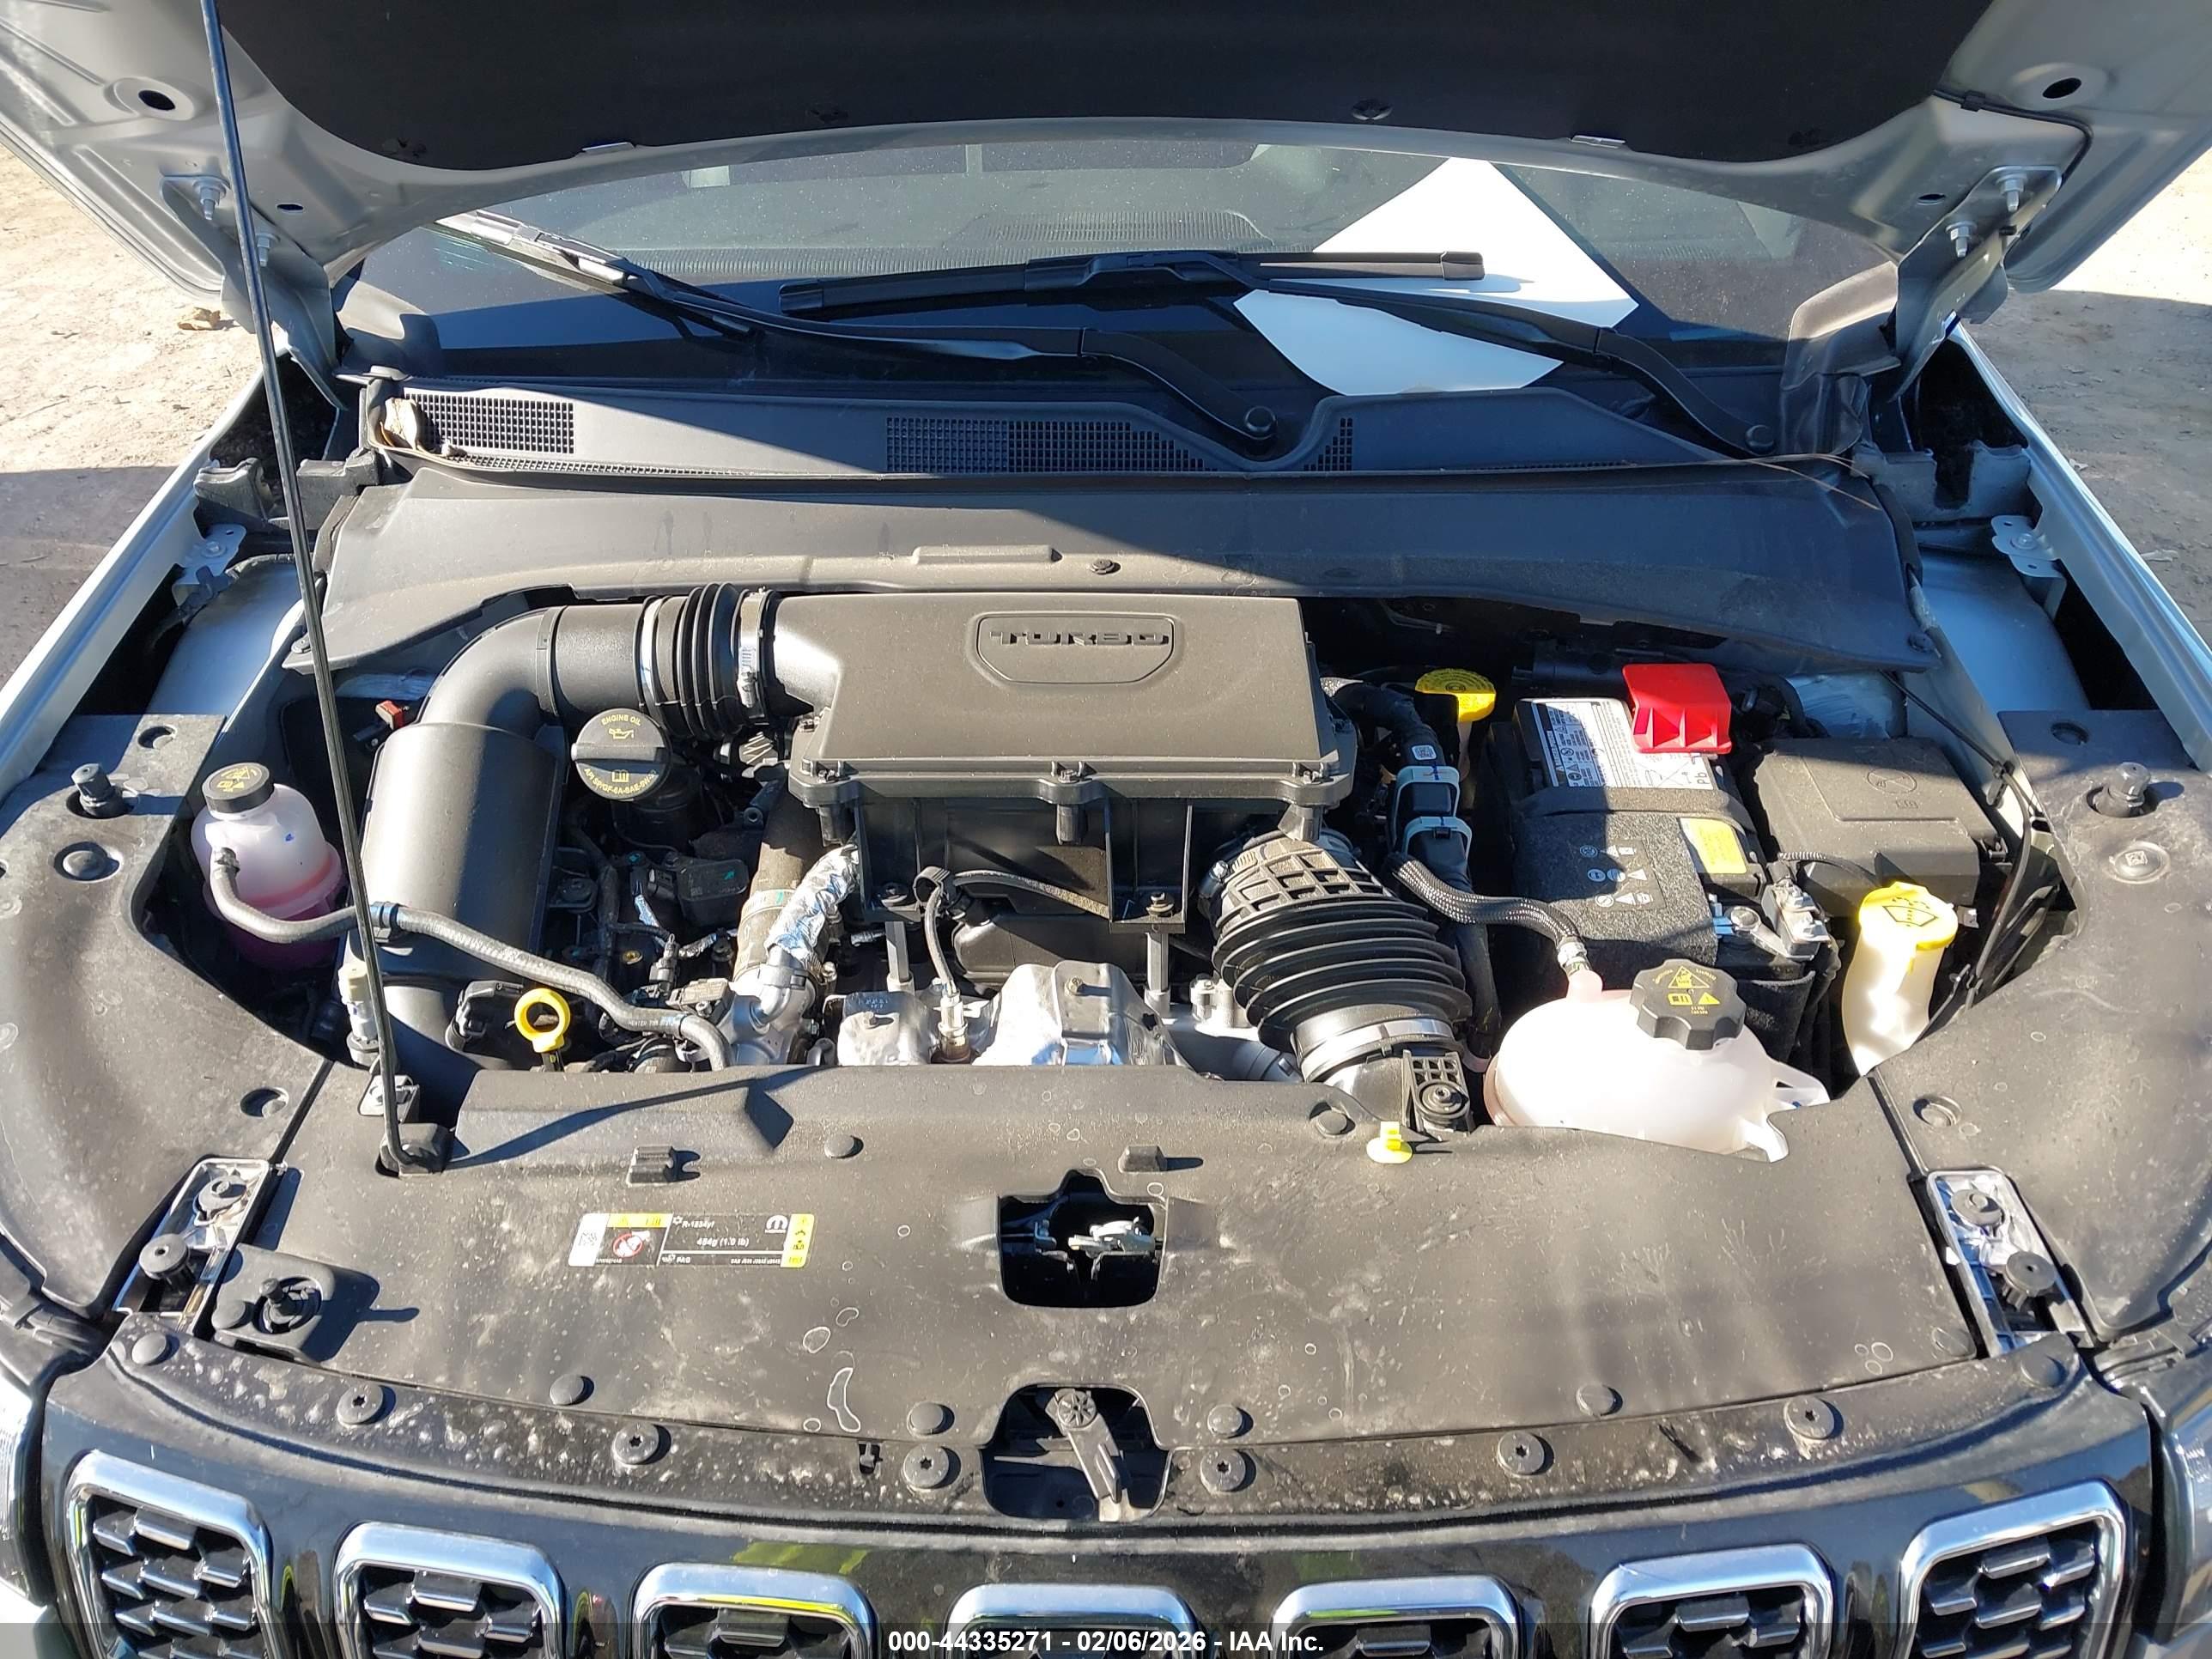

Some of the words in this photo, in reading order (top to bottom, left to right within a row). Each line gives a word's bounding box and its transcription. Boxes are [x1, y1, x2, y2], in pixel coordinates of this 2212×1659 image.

[989, 631, 1170, 646] TURBO
[601, 714, 629, 725] ENGINE
[630, 714, 641, 726] OIL
[1694, 772, 1711, 785] Pb
[738, 1237, 750, 1248] lb)
